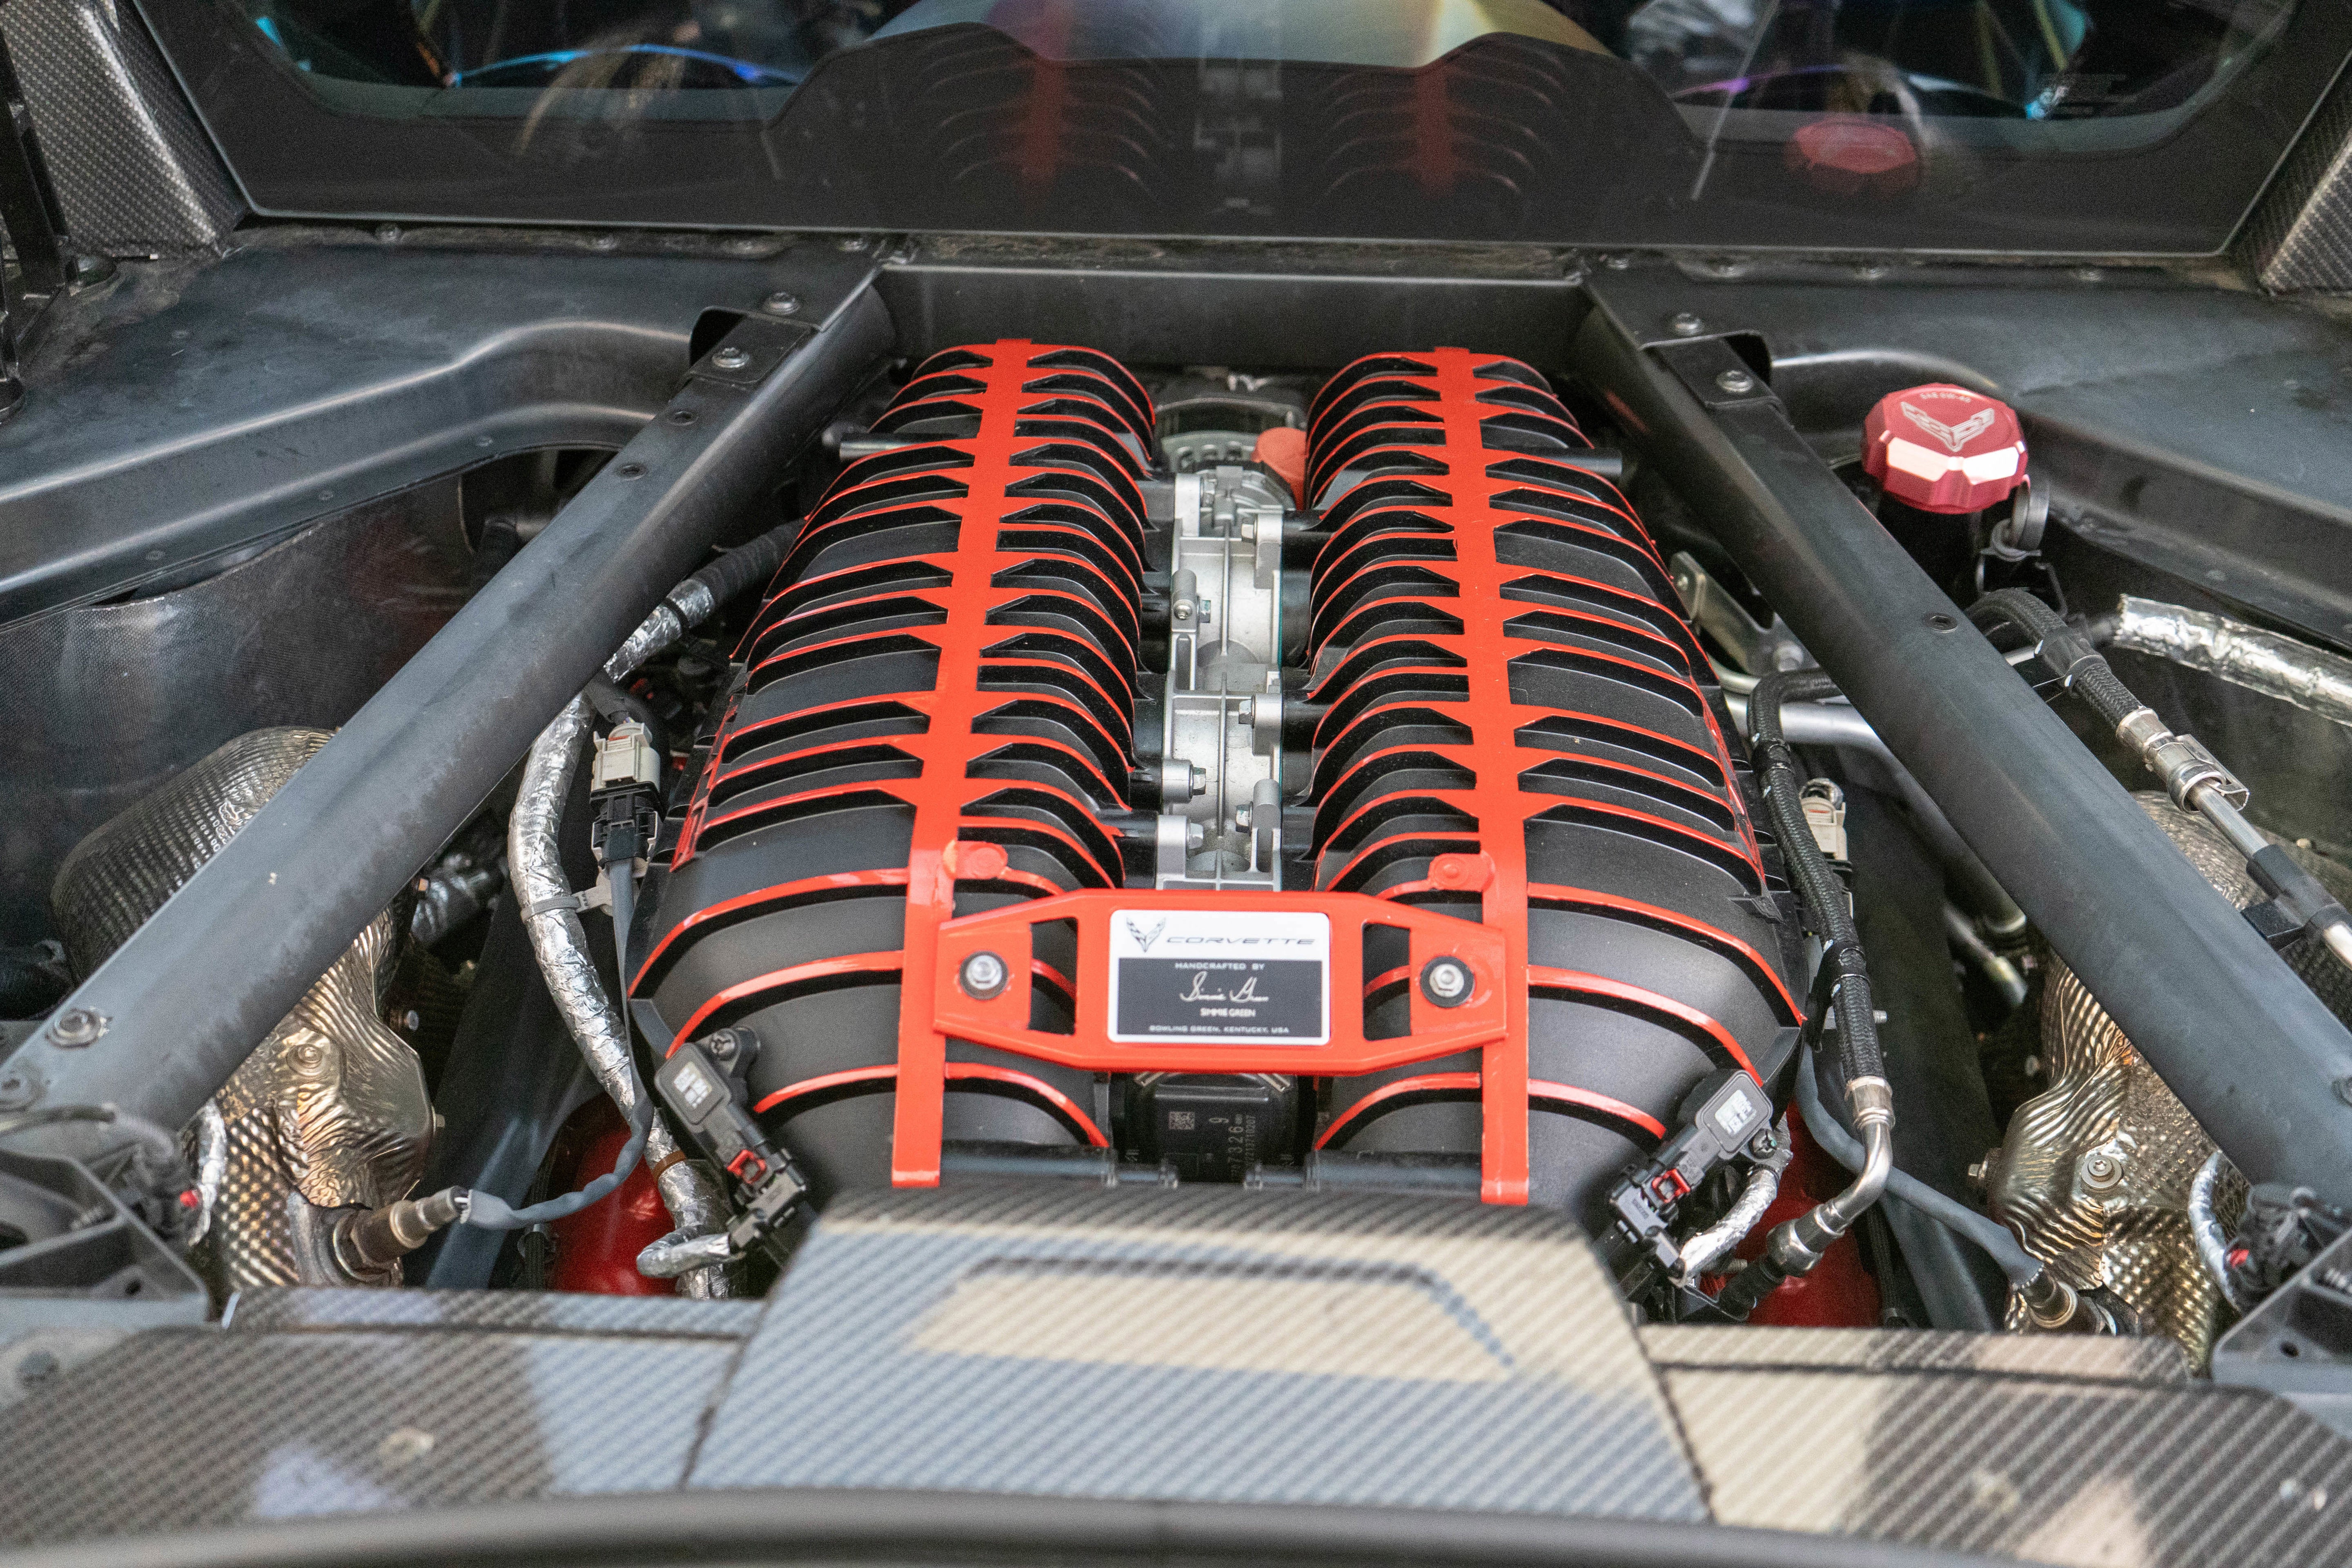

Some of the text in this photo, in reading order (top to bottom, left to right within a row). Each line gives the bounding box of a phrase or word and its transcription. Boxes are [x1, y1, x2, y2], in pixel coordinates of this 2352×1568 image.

[1166, 937, 1315, 945] CORVETTE
[1174, 962, 1247, 970] HANDCRAFTED
[1200, 1007, 1256, 1018] SIMMIE GREEN
